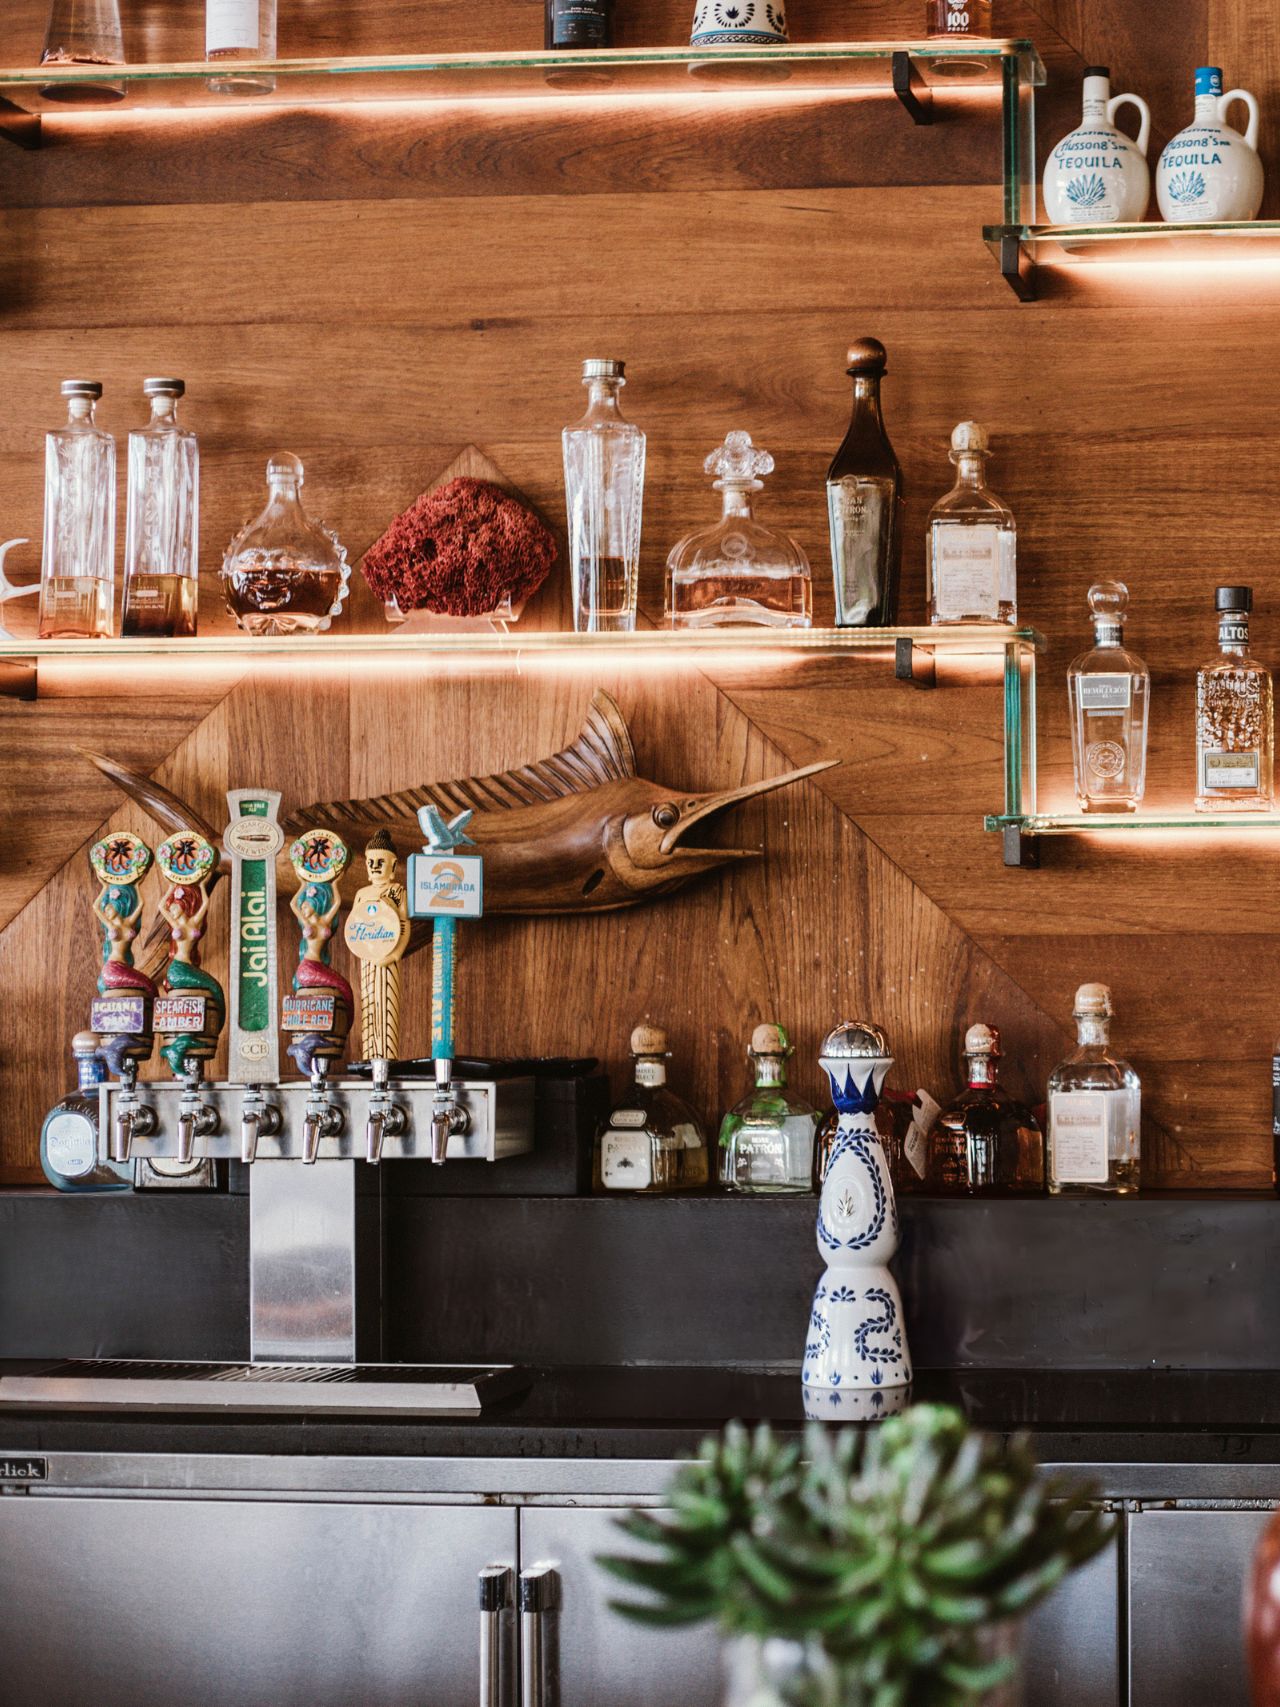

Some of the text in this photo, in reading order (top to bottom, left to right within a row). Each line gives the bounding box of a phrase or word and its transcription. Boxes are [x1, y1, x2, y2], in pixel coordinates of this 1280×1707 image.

[947, 11, 969, 27] 100
[1058, 156, 1123, 170] TEQUILA
[1163, 153, 1222, 169] TEQUILA
[1218, 626, 1249, 640] ALTOS
[420, 881, 475, 892] ISLAMORADA
[429, 861, 464, 908] 2
[242, 946, 268, 988] Jai
[94, 1001, 137, 1013] IGUANA
[155, 999, 204, 1014] SPEARFISH
[284, 999, 334, 1011] HURRICANE
[159, 1015, 201, 1028] AMBER
[241, 1043, 268, 1053] CCB
[739, 1142, 784, 1154] PATRÓN
